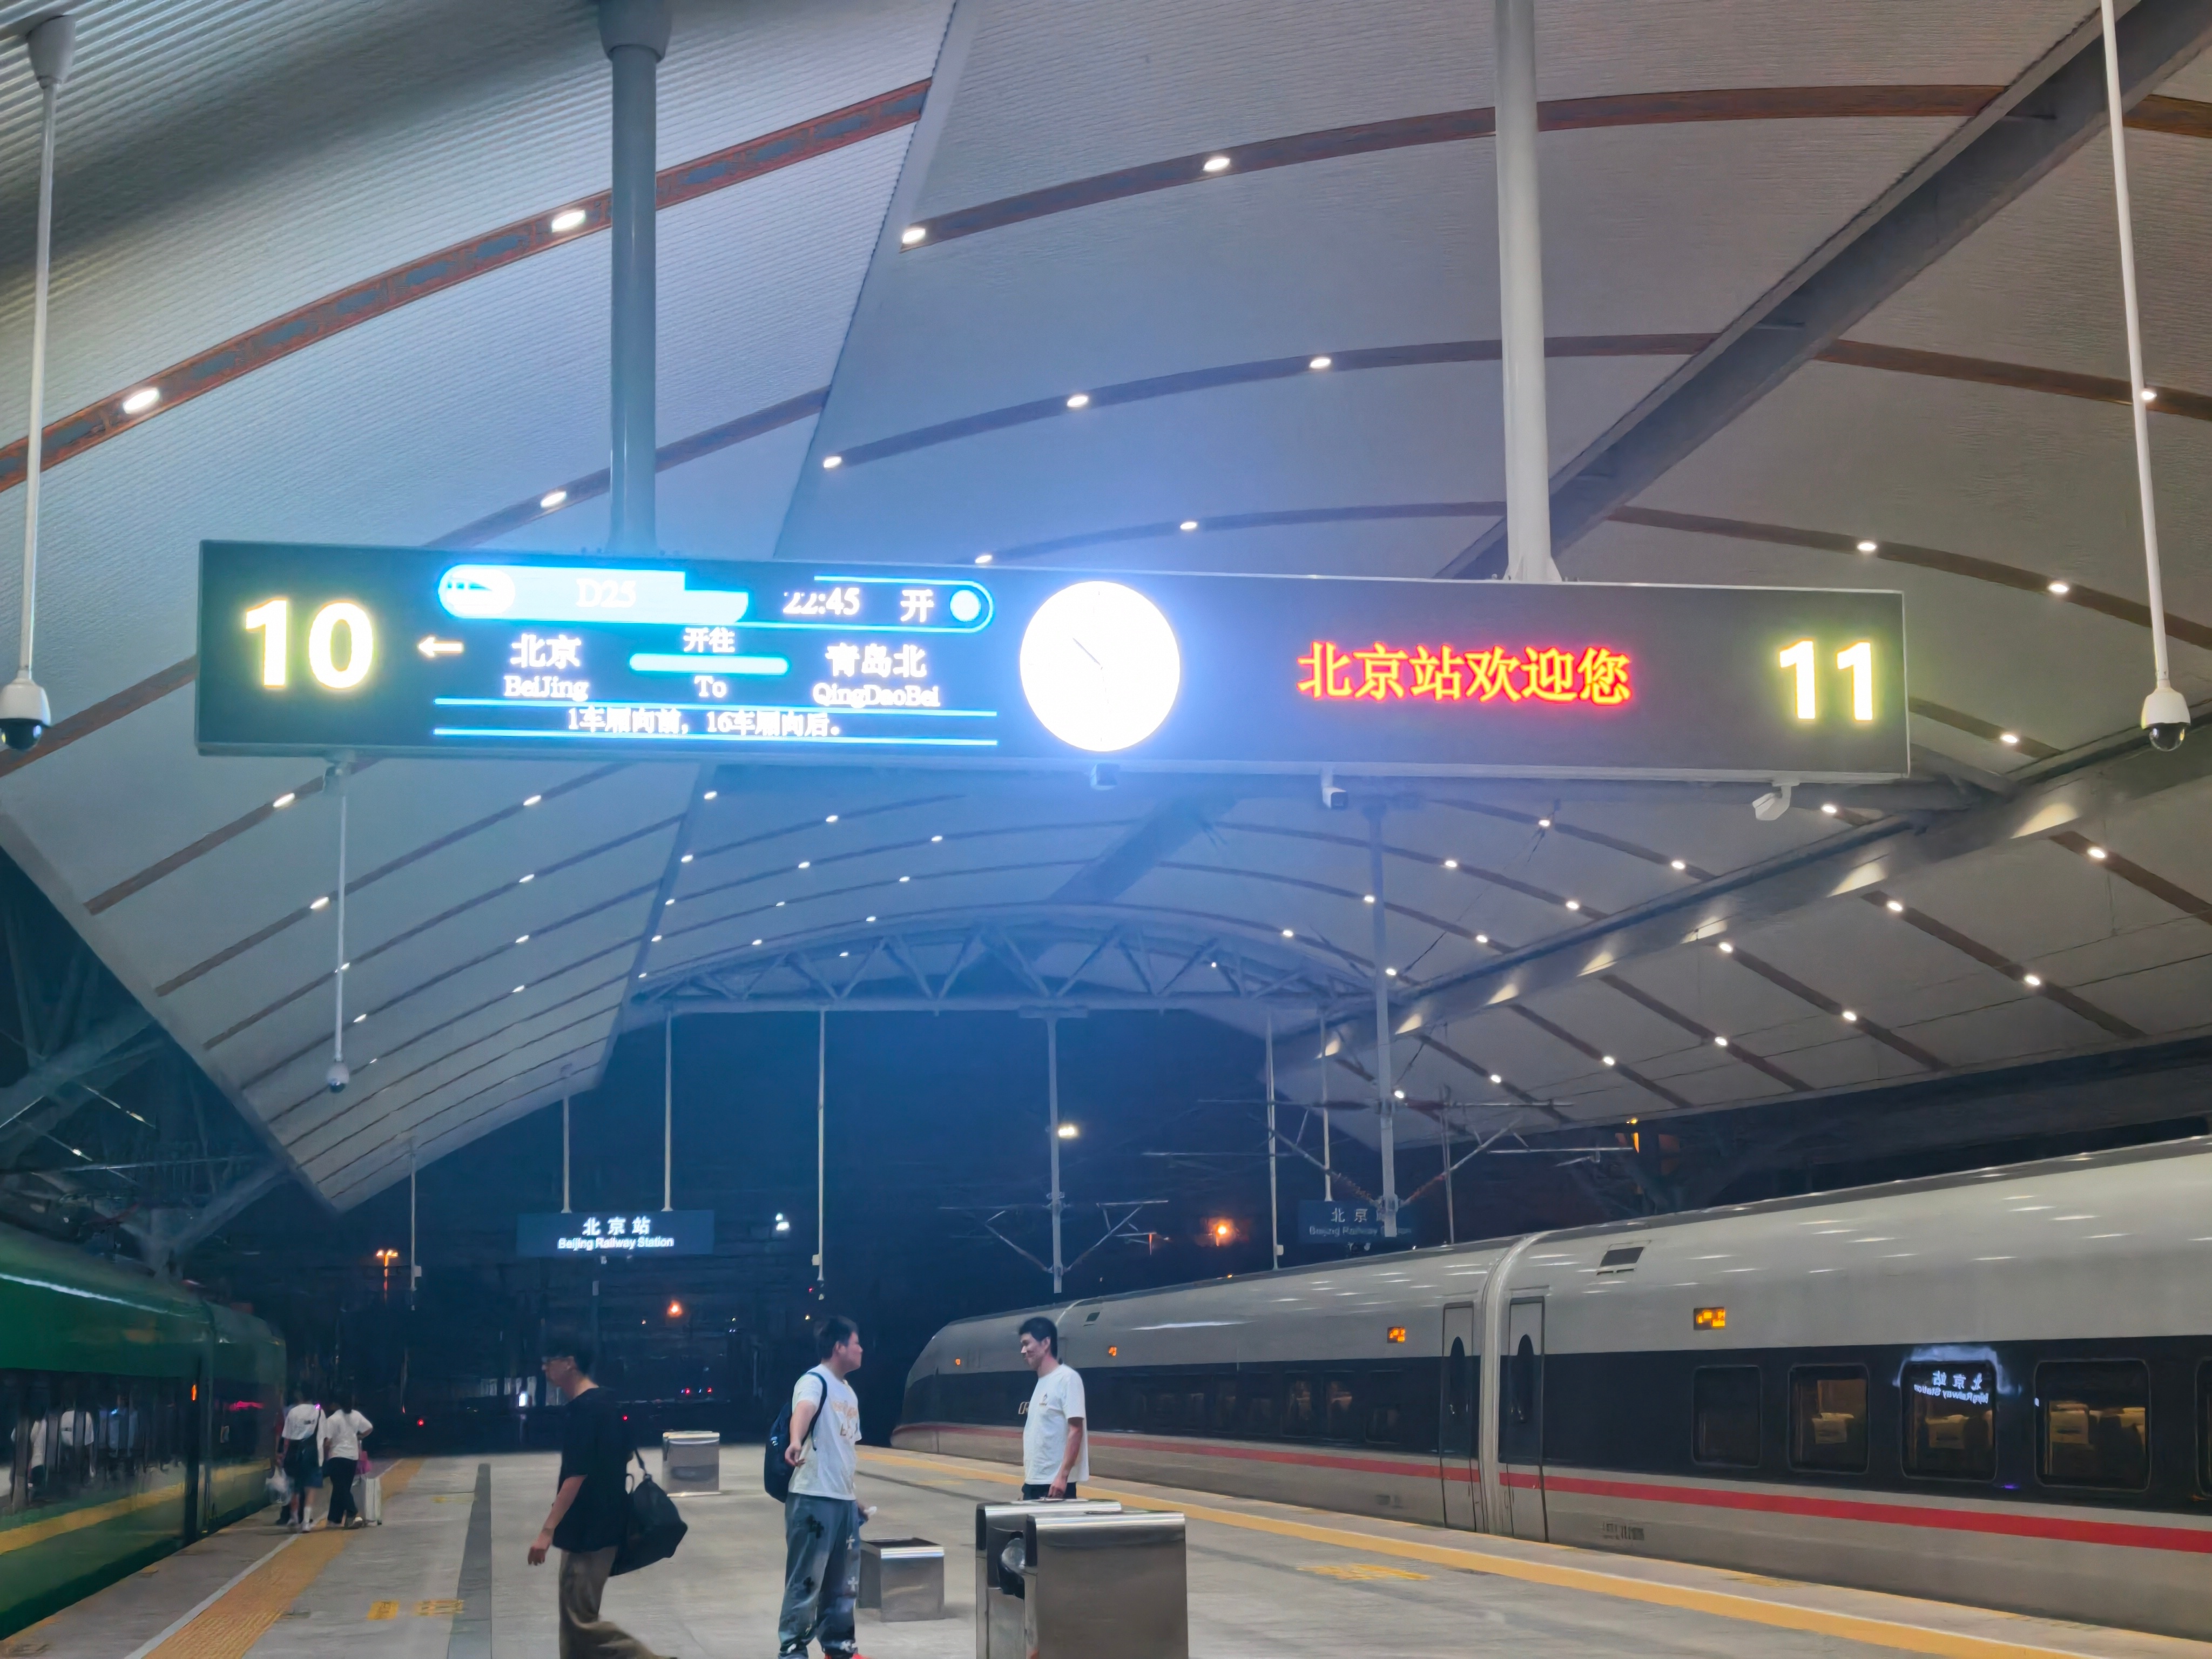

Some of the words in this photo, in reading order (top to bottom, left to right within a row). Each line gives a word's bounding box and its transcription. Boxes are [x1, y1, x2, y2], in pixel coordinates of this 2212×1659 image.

[576, 578, 636, 608] D25
[783, 588, 860, 615] 22:45
[900, 589, 934, 622] 开
[245, 598, 374, 689] 10
[510, 633, 582, 669] 北京
[683, 627, 735, 653] 开往
[825, 643, 927, 678] 青岛北
[1297, 641, 1631, 705] 北京站欢迎您
[503, 676, 589, 702] BeiJing
[694, 676, 727, 698] To
[1779, 639, 1873, 721] 11
[813, 683, 941, 709] QingDaoBei
[582, 1216, 651, 1236] 北京站
[557, 1237, 594, 1251] Beijing
[595, 1237, 636, 1250] Railway
[637, 1235, 675, 1247] Station
